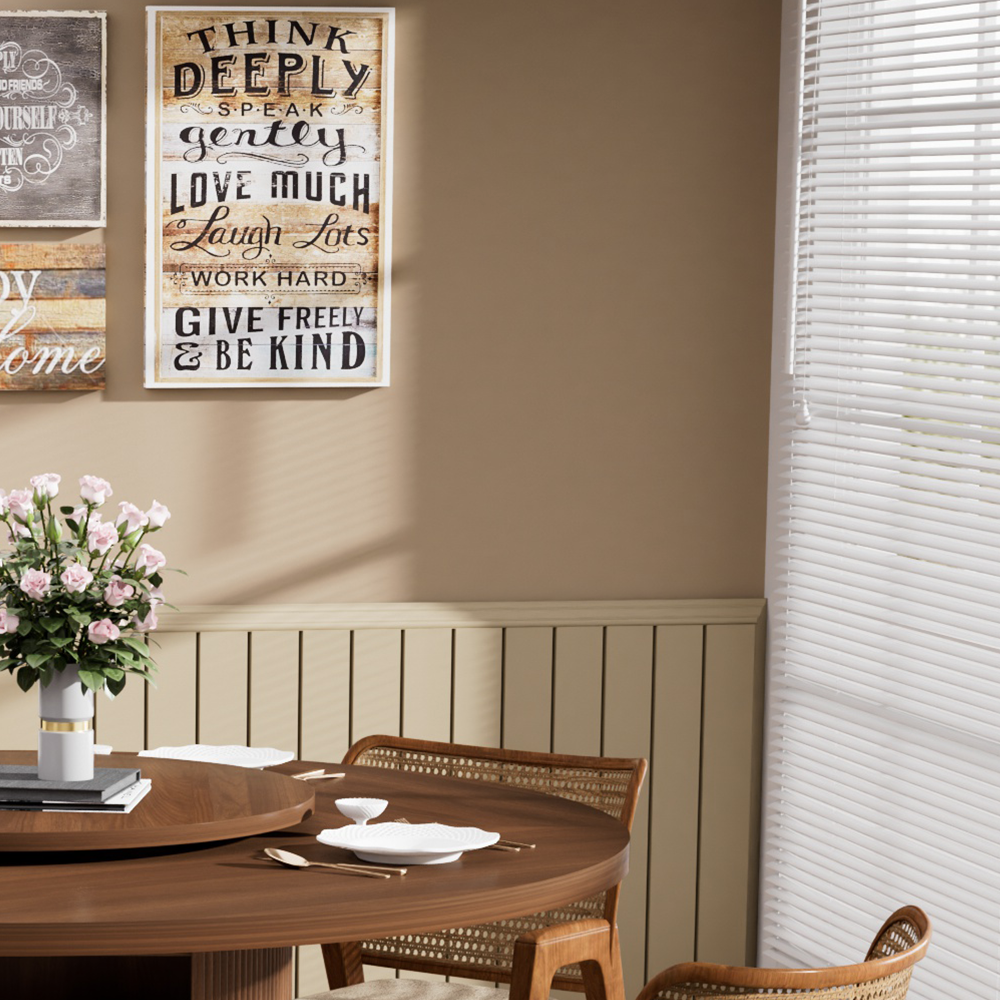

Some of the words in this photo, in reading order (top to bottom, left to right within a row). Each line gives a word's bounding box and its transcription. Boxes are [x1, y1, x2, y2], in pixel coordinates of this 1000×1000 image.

[187, 19, 358, 54] THINK
[8, 79, 43, 91] FRIENDS
[173, 52, 373, 99] DEEPLY
[179, 119, 366, 167] gently
[170, 170, 252, 215] LOVE
[271, 170, 370, 215] MUCH
[165, 205, 282, 260] Laugh
[292, 212, 371, 254] Lots
[190, 270, 267, 287] WORK
[277, 271, 347, 287] HARD
[174, 306, 264, 337] GIVE
[278, 306, 365, 331] FREELY
[173, 341, 203, 371] &
[216, 338, 253, 371] BE
[269, 331, 366, 371] KIND
